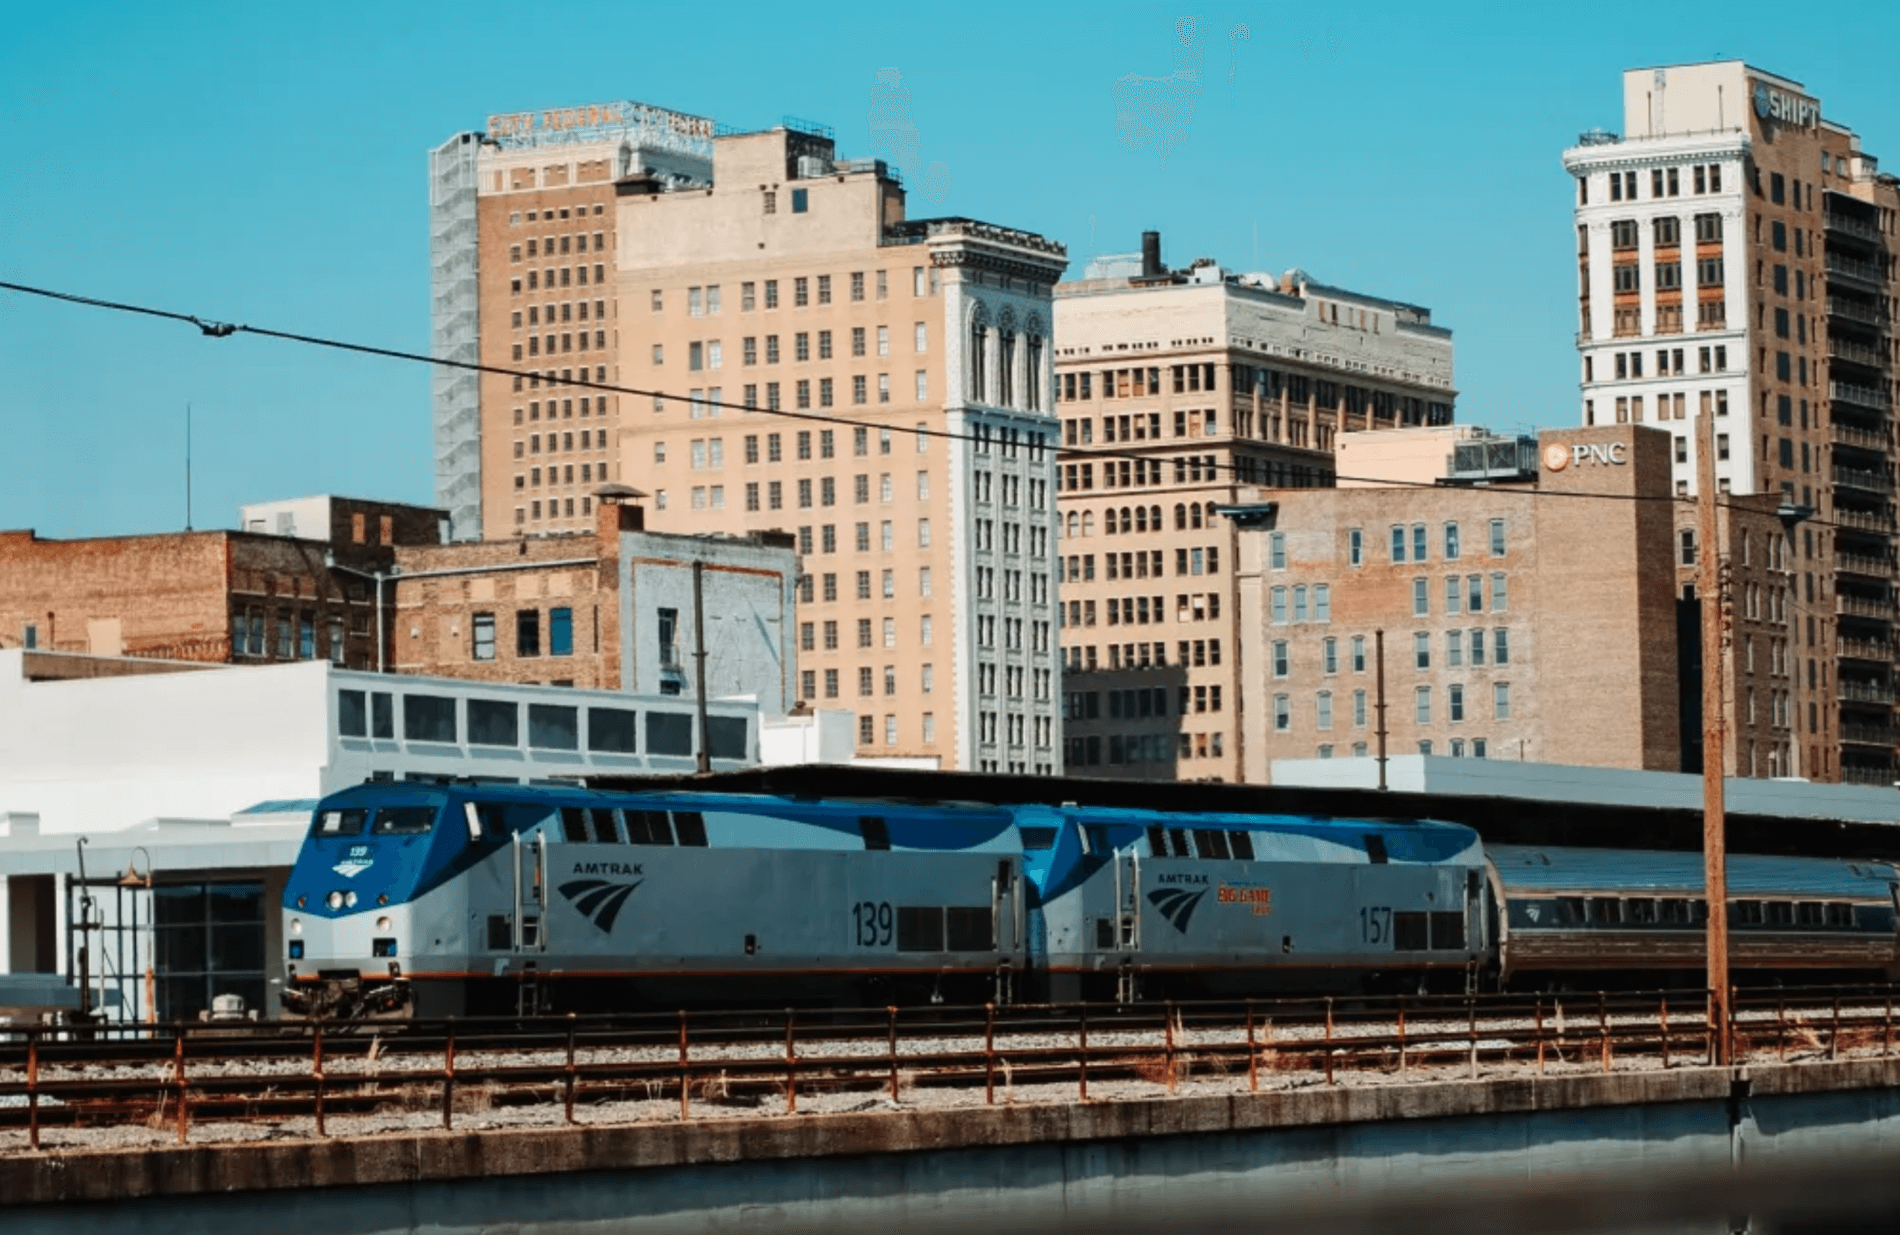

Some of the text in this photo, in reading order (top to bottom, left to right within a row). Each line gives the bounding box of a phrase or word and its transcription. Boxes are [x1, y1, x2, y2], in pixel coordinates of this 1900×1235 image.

[1769, 90, 1819, 130] SHIPT
[1572, 441, 1626, 467] PNC
[573, 862, 643, 875] AMTRAK
[1158, 874, 1208, 885] AMTRAK
[852, 901, 893, 947] 139
[1360, 906, 1391, 944] 157
